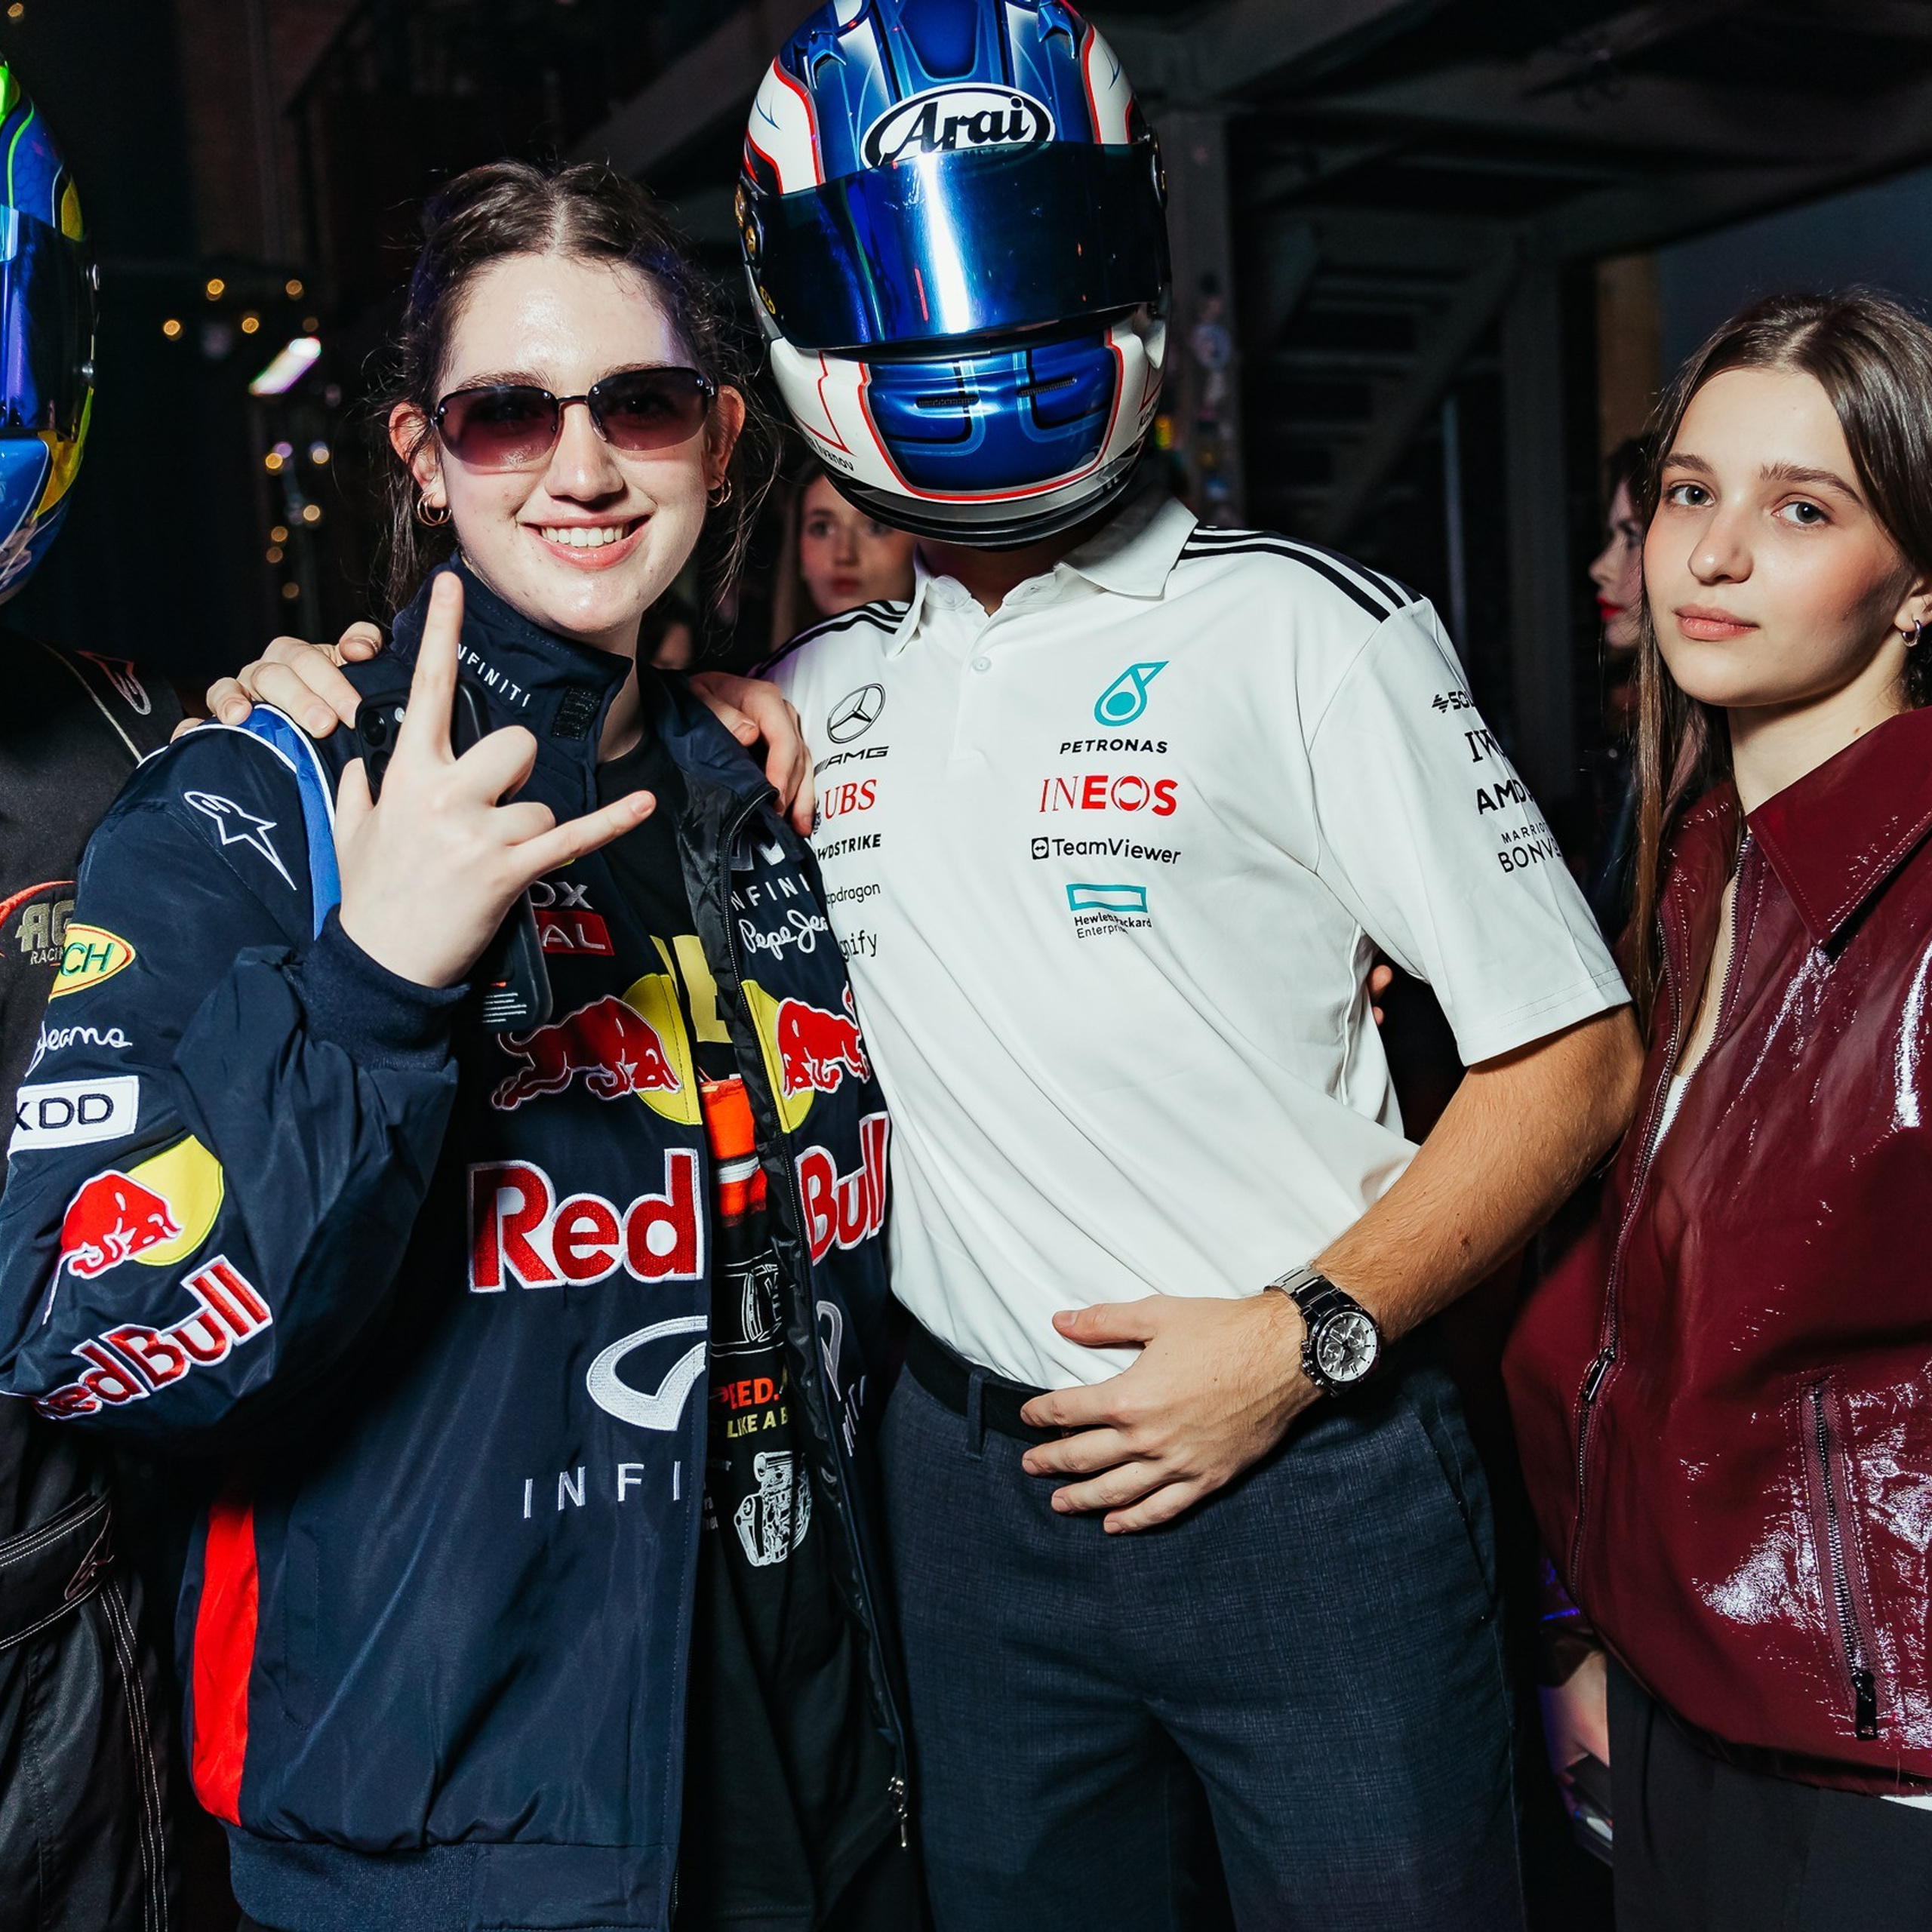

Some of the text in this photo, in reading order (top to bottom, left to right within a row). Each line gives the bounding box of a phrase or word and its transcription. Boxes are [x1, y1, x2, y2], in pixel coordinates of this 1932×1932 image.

[879, 96, 1031, 162] Arai
[825, 746, 889, 770] AMG
[1060, 739, 1168, 754] PETRONAS
[825, 779, 877, 820] UBS
[1040, 775, 1178, 816] INEOS
[1052, 838, 1181, 864] TeamViewer
[1501, 821, 1546, 844] MARRIO
[739, 918, 797, 960] Pepe
[468, 1112, 889, 1292] Red Bull
[98, 1254, 273, 1392] Bull
[727, 1414, 758, 1438] LIKE
[762, 1410, 777, 1430] A
[524, 1460, 681, 1519] INFI
